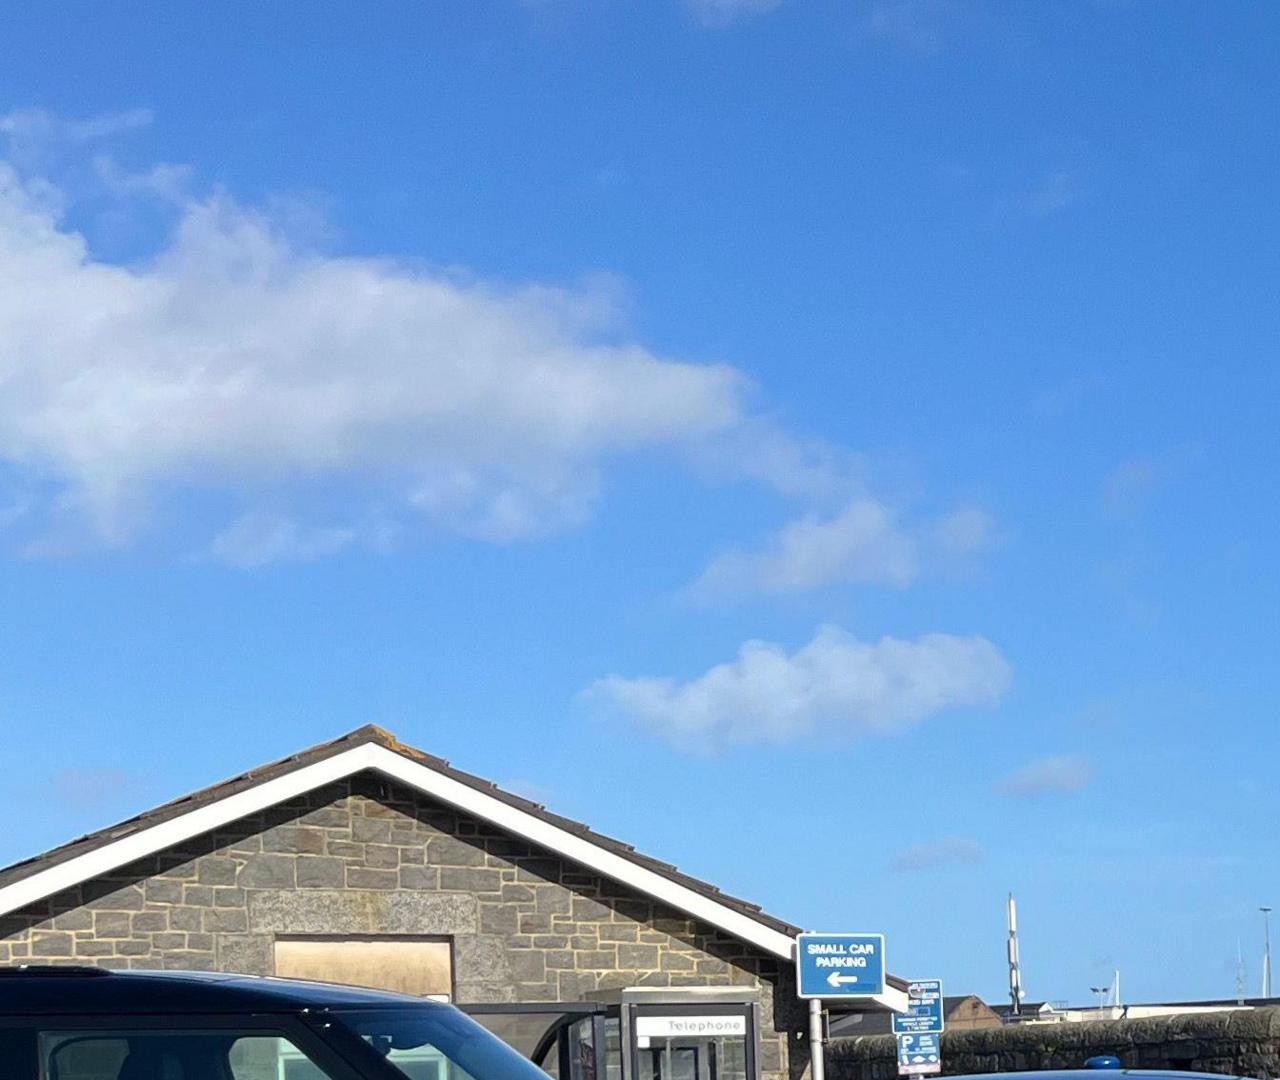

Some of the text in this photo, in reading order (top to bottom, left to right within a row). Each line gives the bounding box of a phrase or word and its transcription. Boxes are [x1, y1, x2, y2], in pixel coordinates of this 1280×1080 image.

[807, 943, 874, 955] SMALL CAR
[816, 956, 867, 968] PARKING
[669, 1020, 741, 1032] Telephone
[902, 1035, 913, 1049] P
